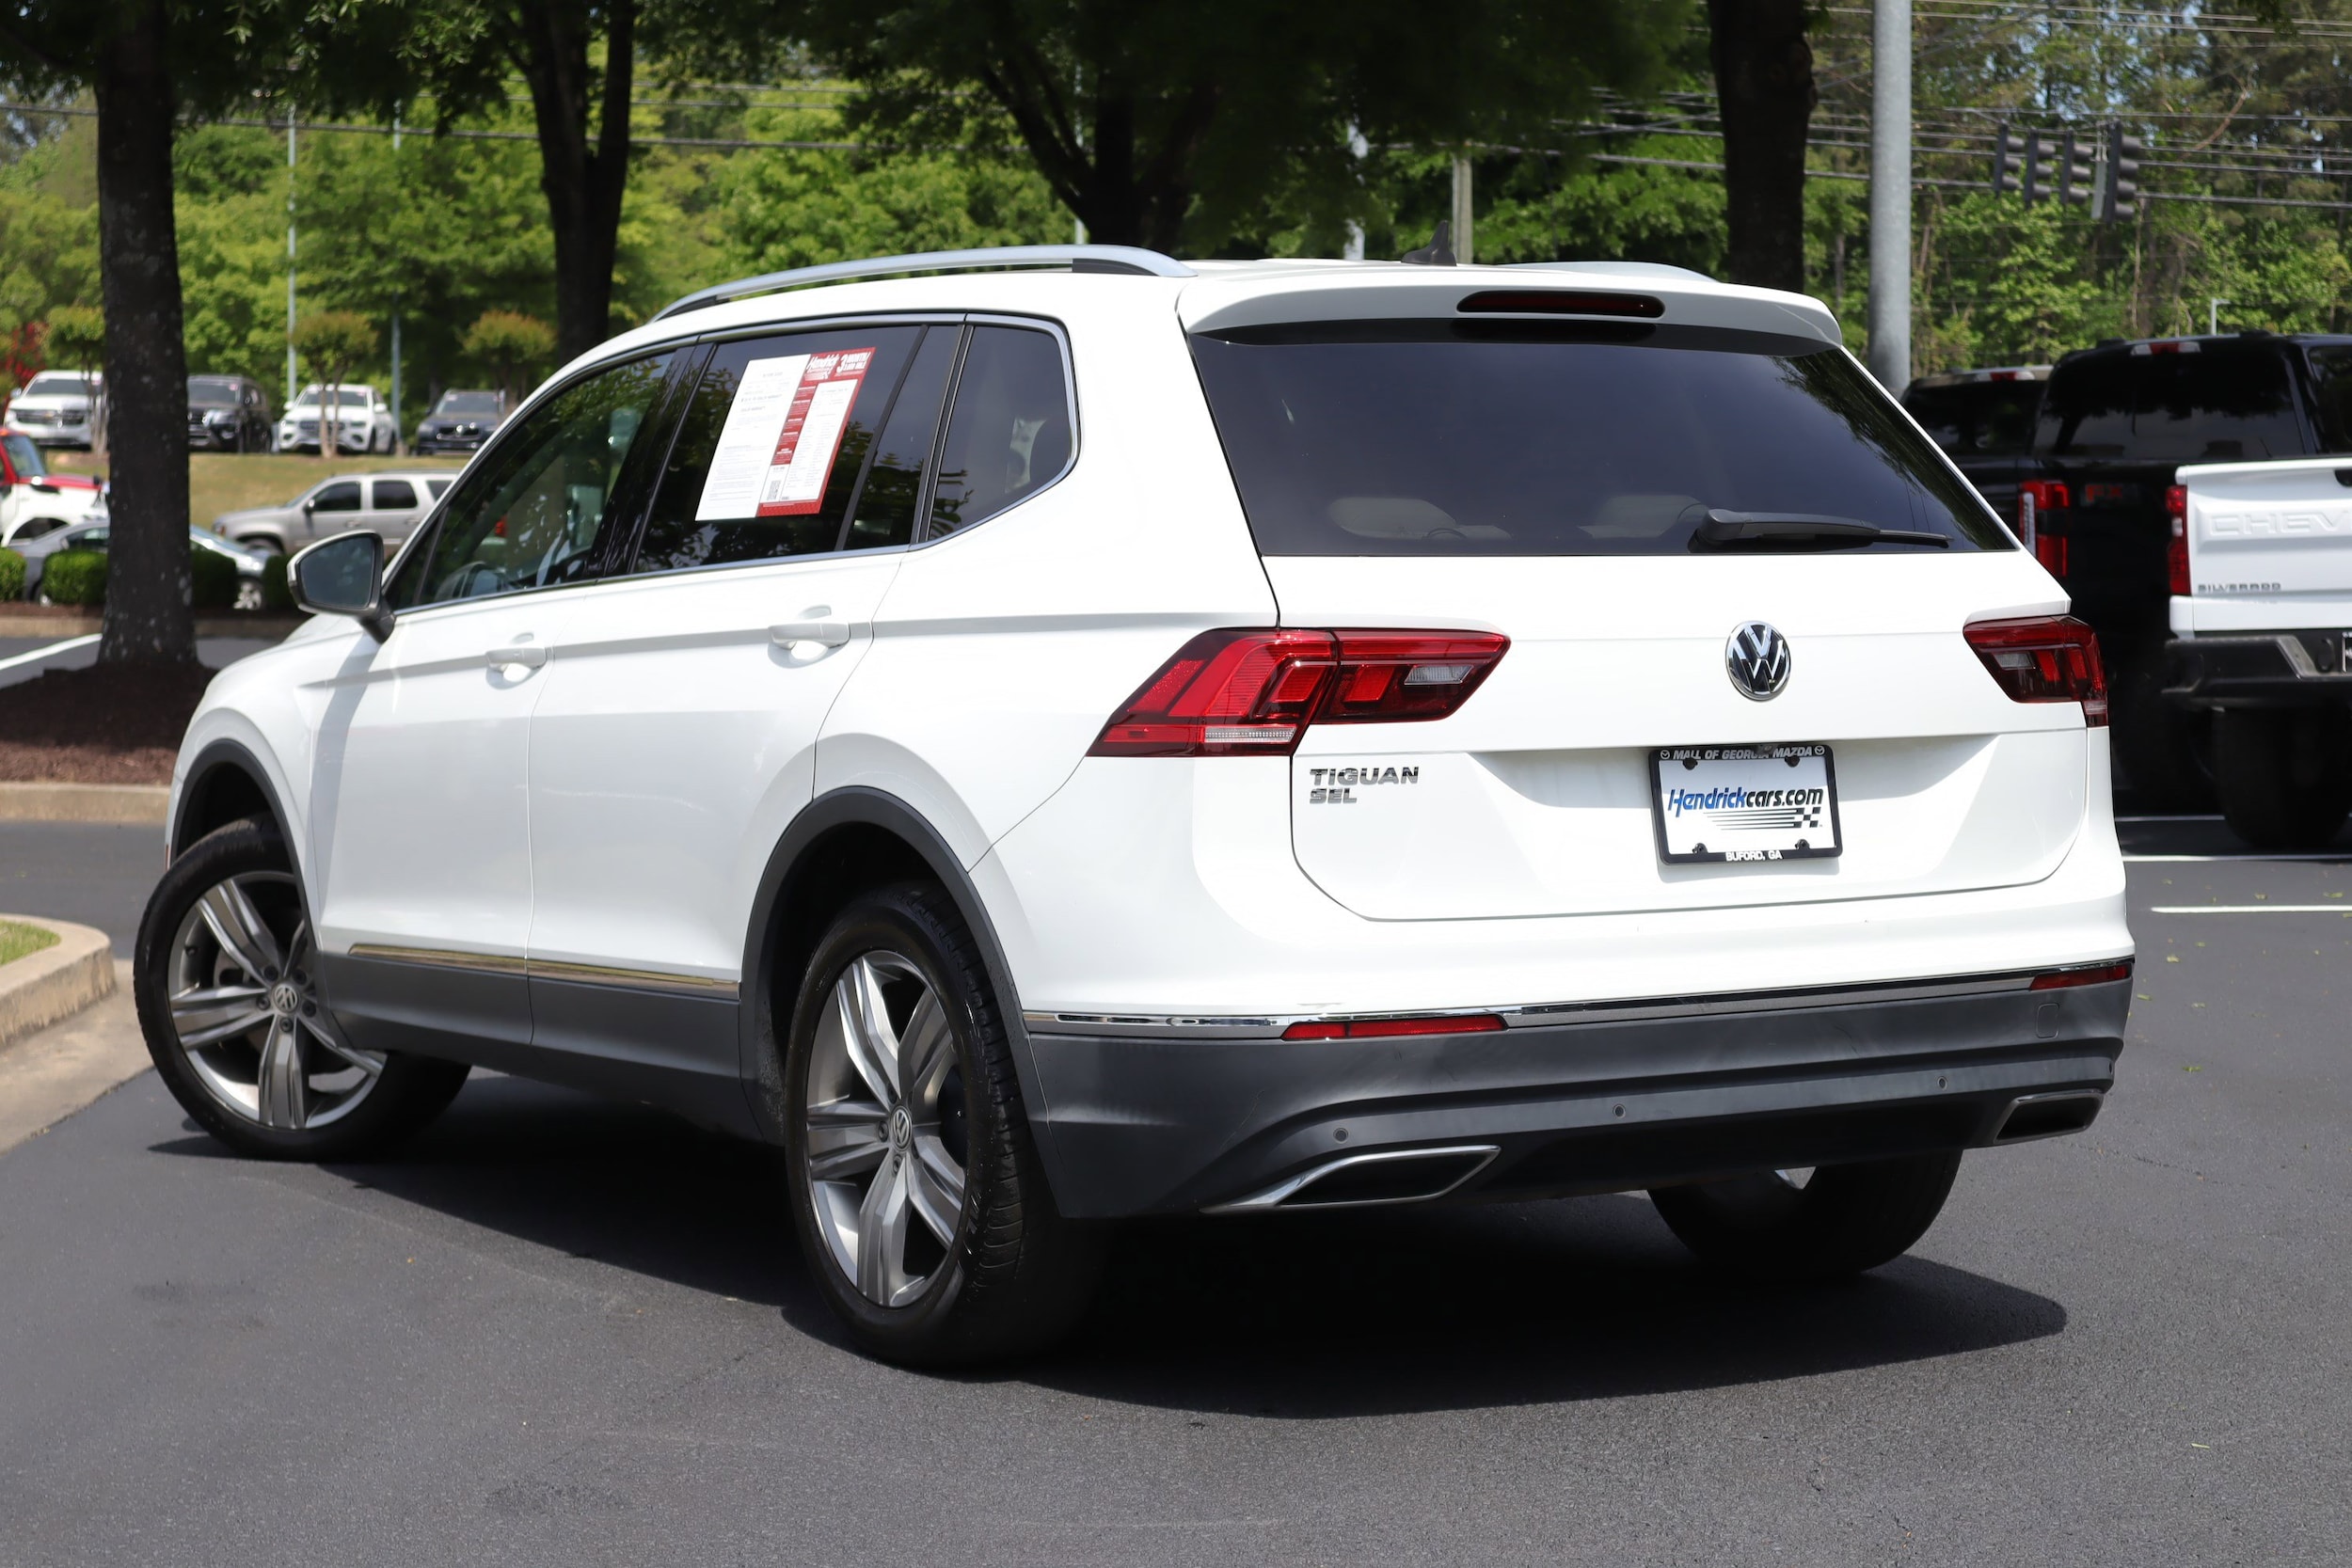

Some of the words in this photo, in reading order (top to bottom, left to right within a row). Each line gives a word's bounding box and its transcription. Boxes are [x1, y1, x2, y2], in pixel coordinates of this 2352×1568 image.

[2210, 511, 2352, 535] CHEV
[2198, 582, 2281, 593] SILVERADO
[1673, 750, 1701, 760] MALL
[1705, 749, 1720, 760] OF
[1772, 746, 1812, 758] MAZDA
[1310, 767, 1419, 786] TIGUAN
[1310, 788, 1357, 804] SEL
[1668, 787, 1823, 817] Hendrickcars.com
[1725, 850, 1766, 862] BUFORD,
[1768, 850, 1783, 860] GA
